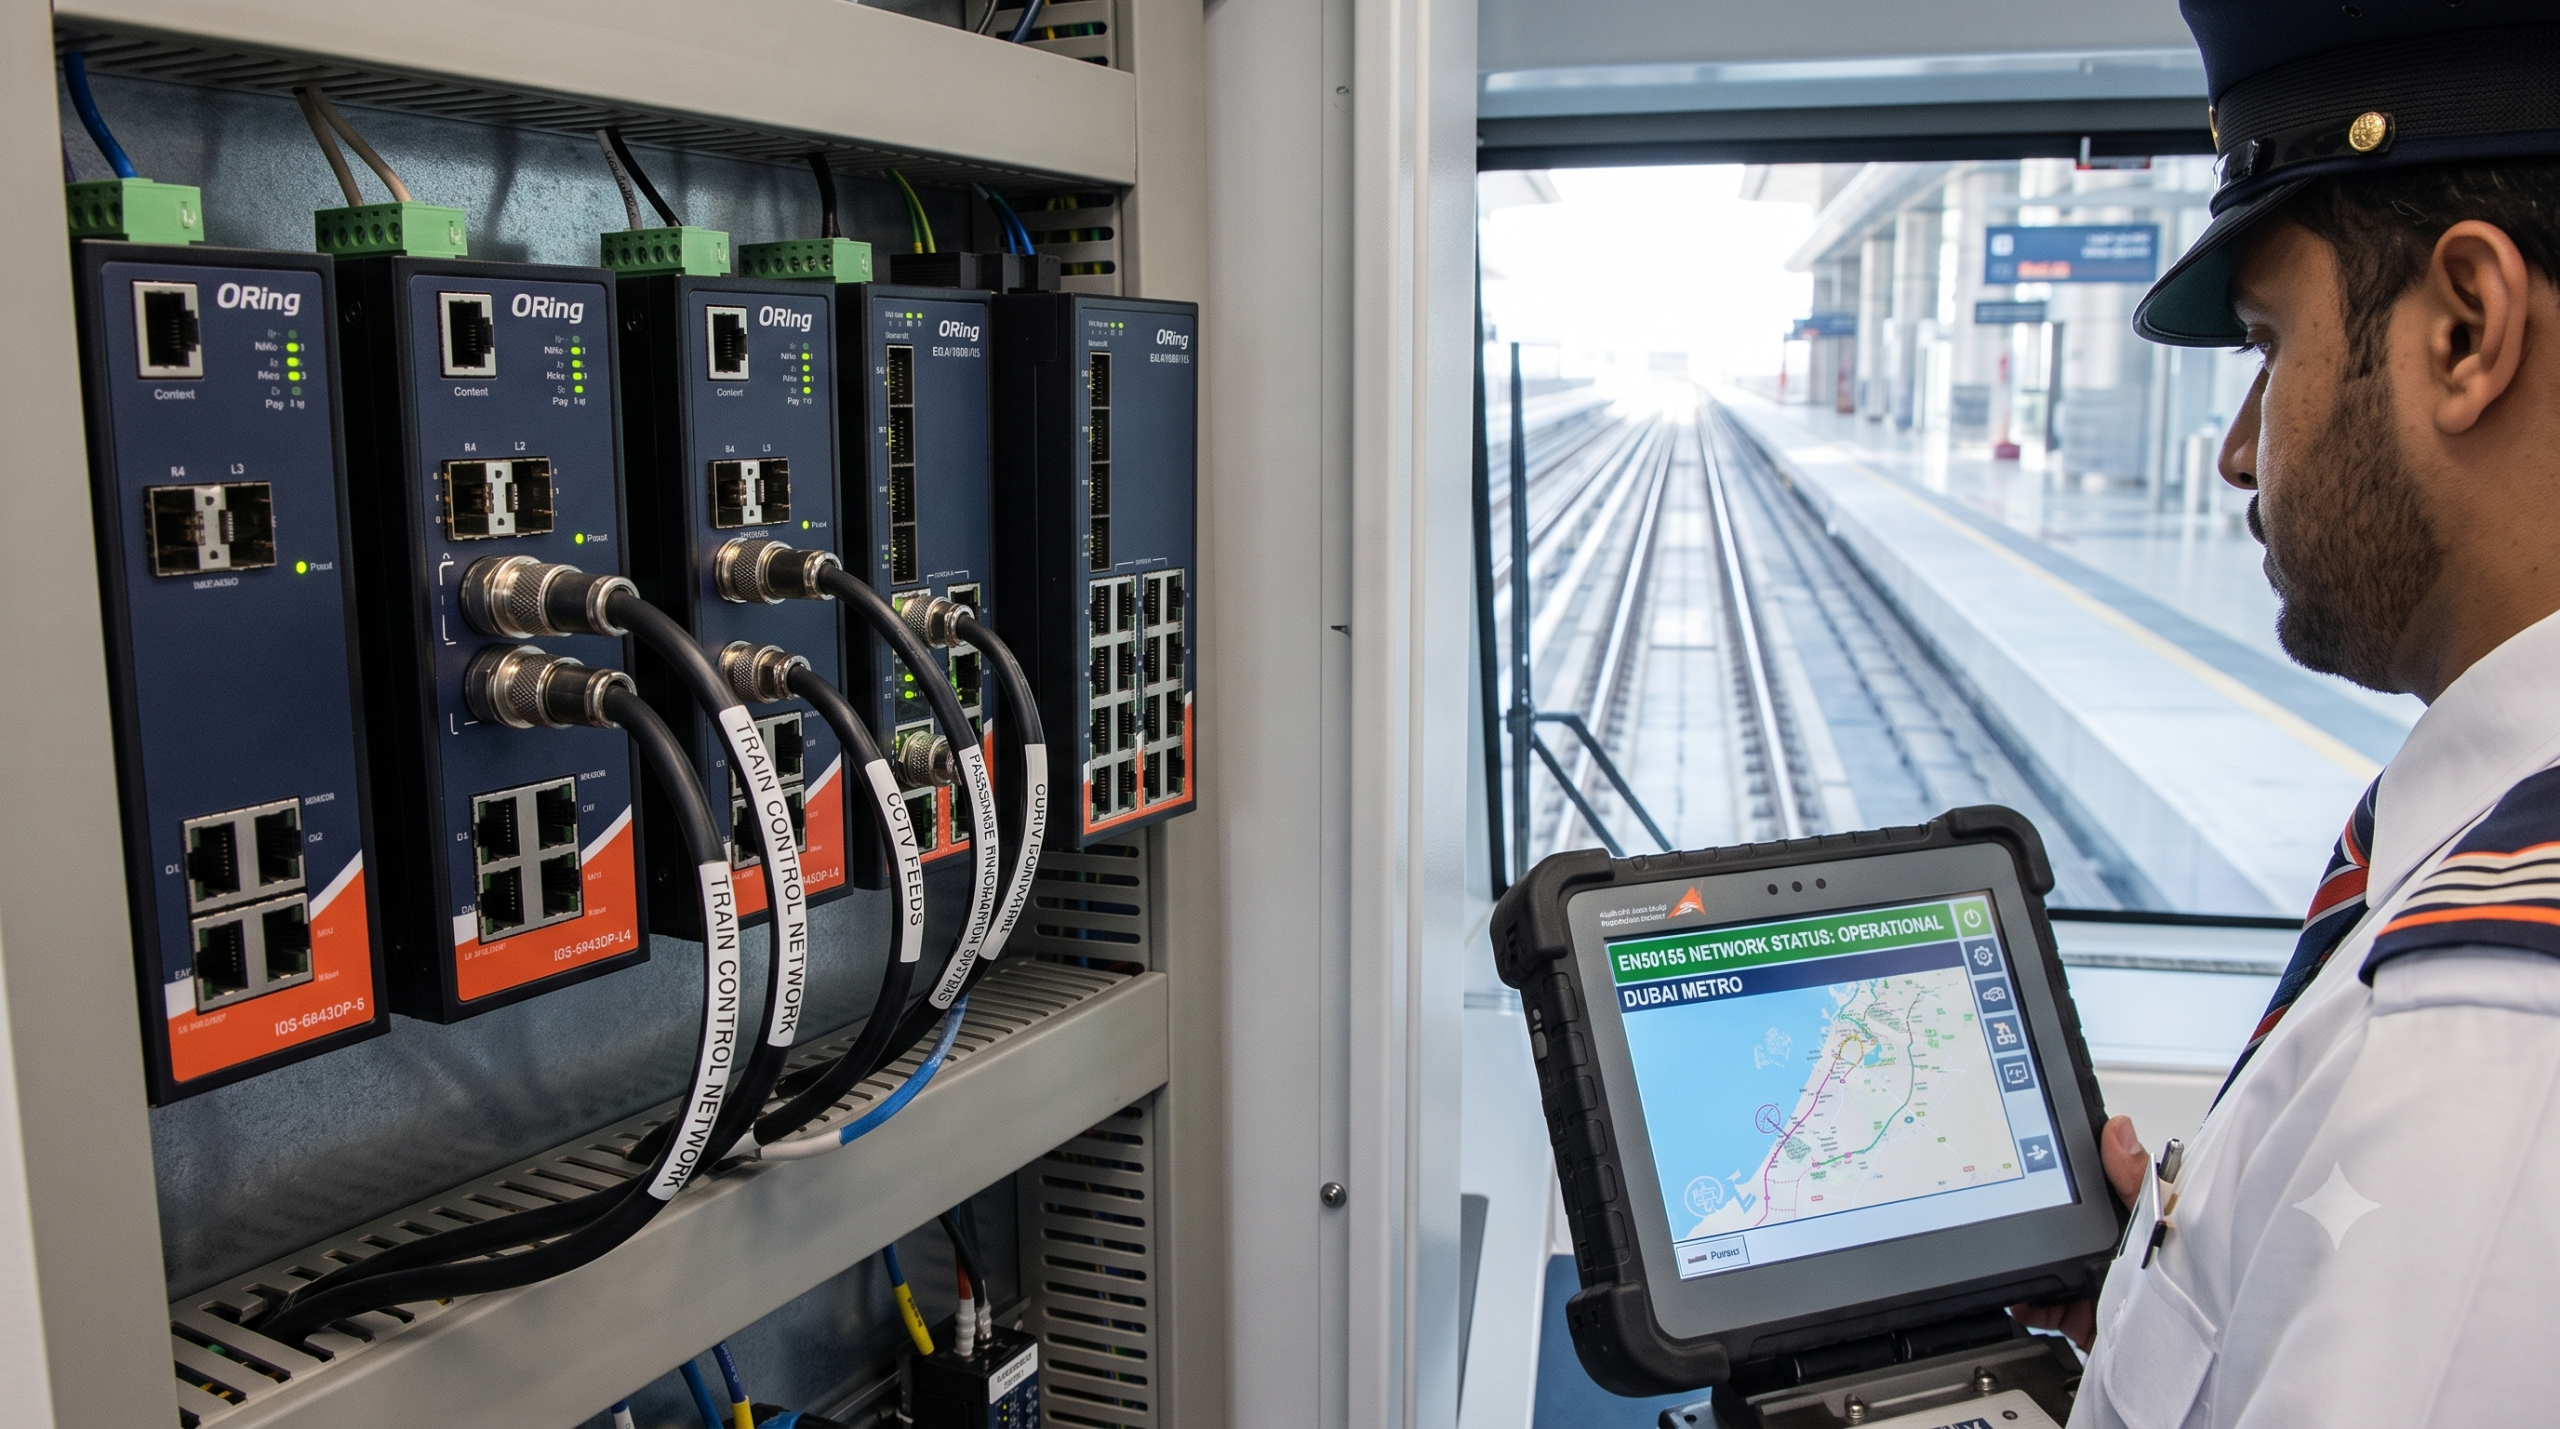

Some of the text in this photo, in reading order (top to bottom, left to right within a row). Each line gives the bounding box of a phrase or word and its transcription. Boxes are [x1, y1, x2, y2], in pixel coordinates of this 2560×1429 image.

[217, 282, 301, 317] ORing
[511, 293, 584, 325] ORing
[938, 320, 980, 342] ORing
[1156, 328, 1189, 350] ORing
[454, 386, 489, 397] Content
[514, 441, 526, 451] L2
[171, 466, 186, 477] R4
[231, 463, 245, 475] L3
[886, 792, 923, 926] CCTV FEEDS
[736, 720, 804, 1035] TRAIN CONTROL NETWORK
[1618, 915, 1944, 972] EN50155 NETWORK STATUS: OPERATIONAL
[1623, 976, 1743, 1008] DUBAI METRO
[662, 874, 738, 1188] TRAIN CONTROL NETWORK
